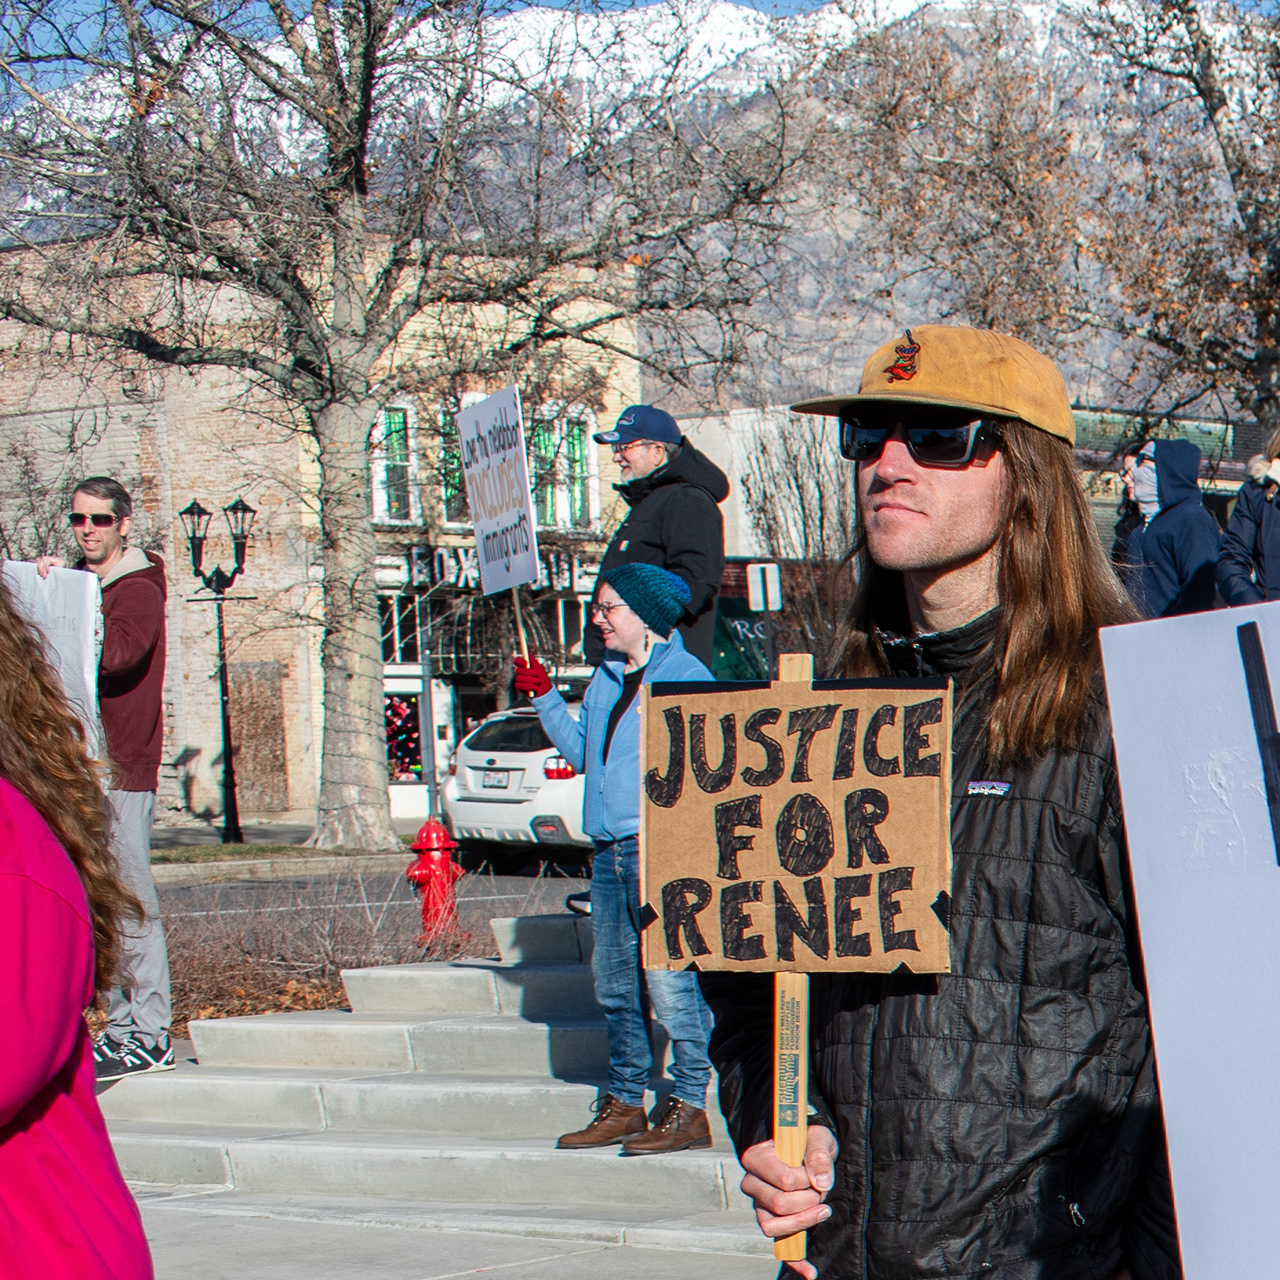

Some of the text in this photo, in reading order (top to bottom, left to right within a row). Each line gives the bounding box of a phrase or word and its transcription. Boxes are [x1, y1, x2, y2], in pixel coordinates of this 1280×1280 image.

[468, 452, 524, 523] INCLUDES
[481, 510, 530, 573] immigrants
[644, 697, 943, 808] JUSTICE
[714, 788, 890, 880] FOR
[661, 867, 920, 961] RENEE
